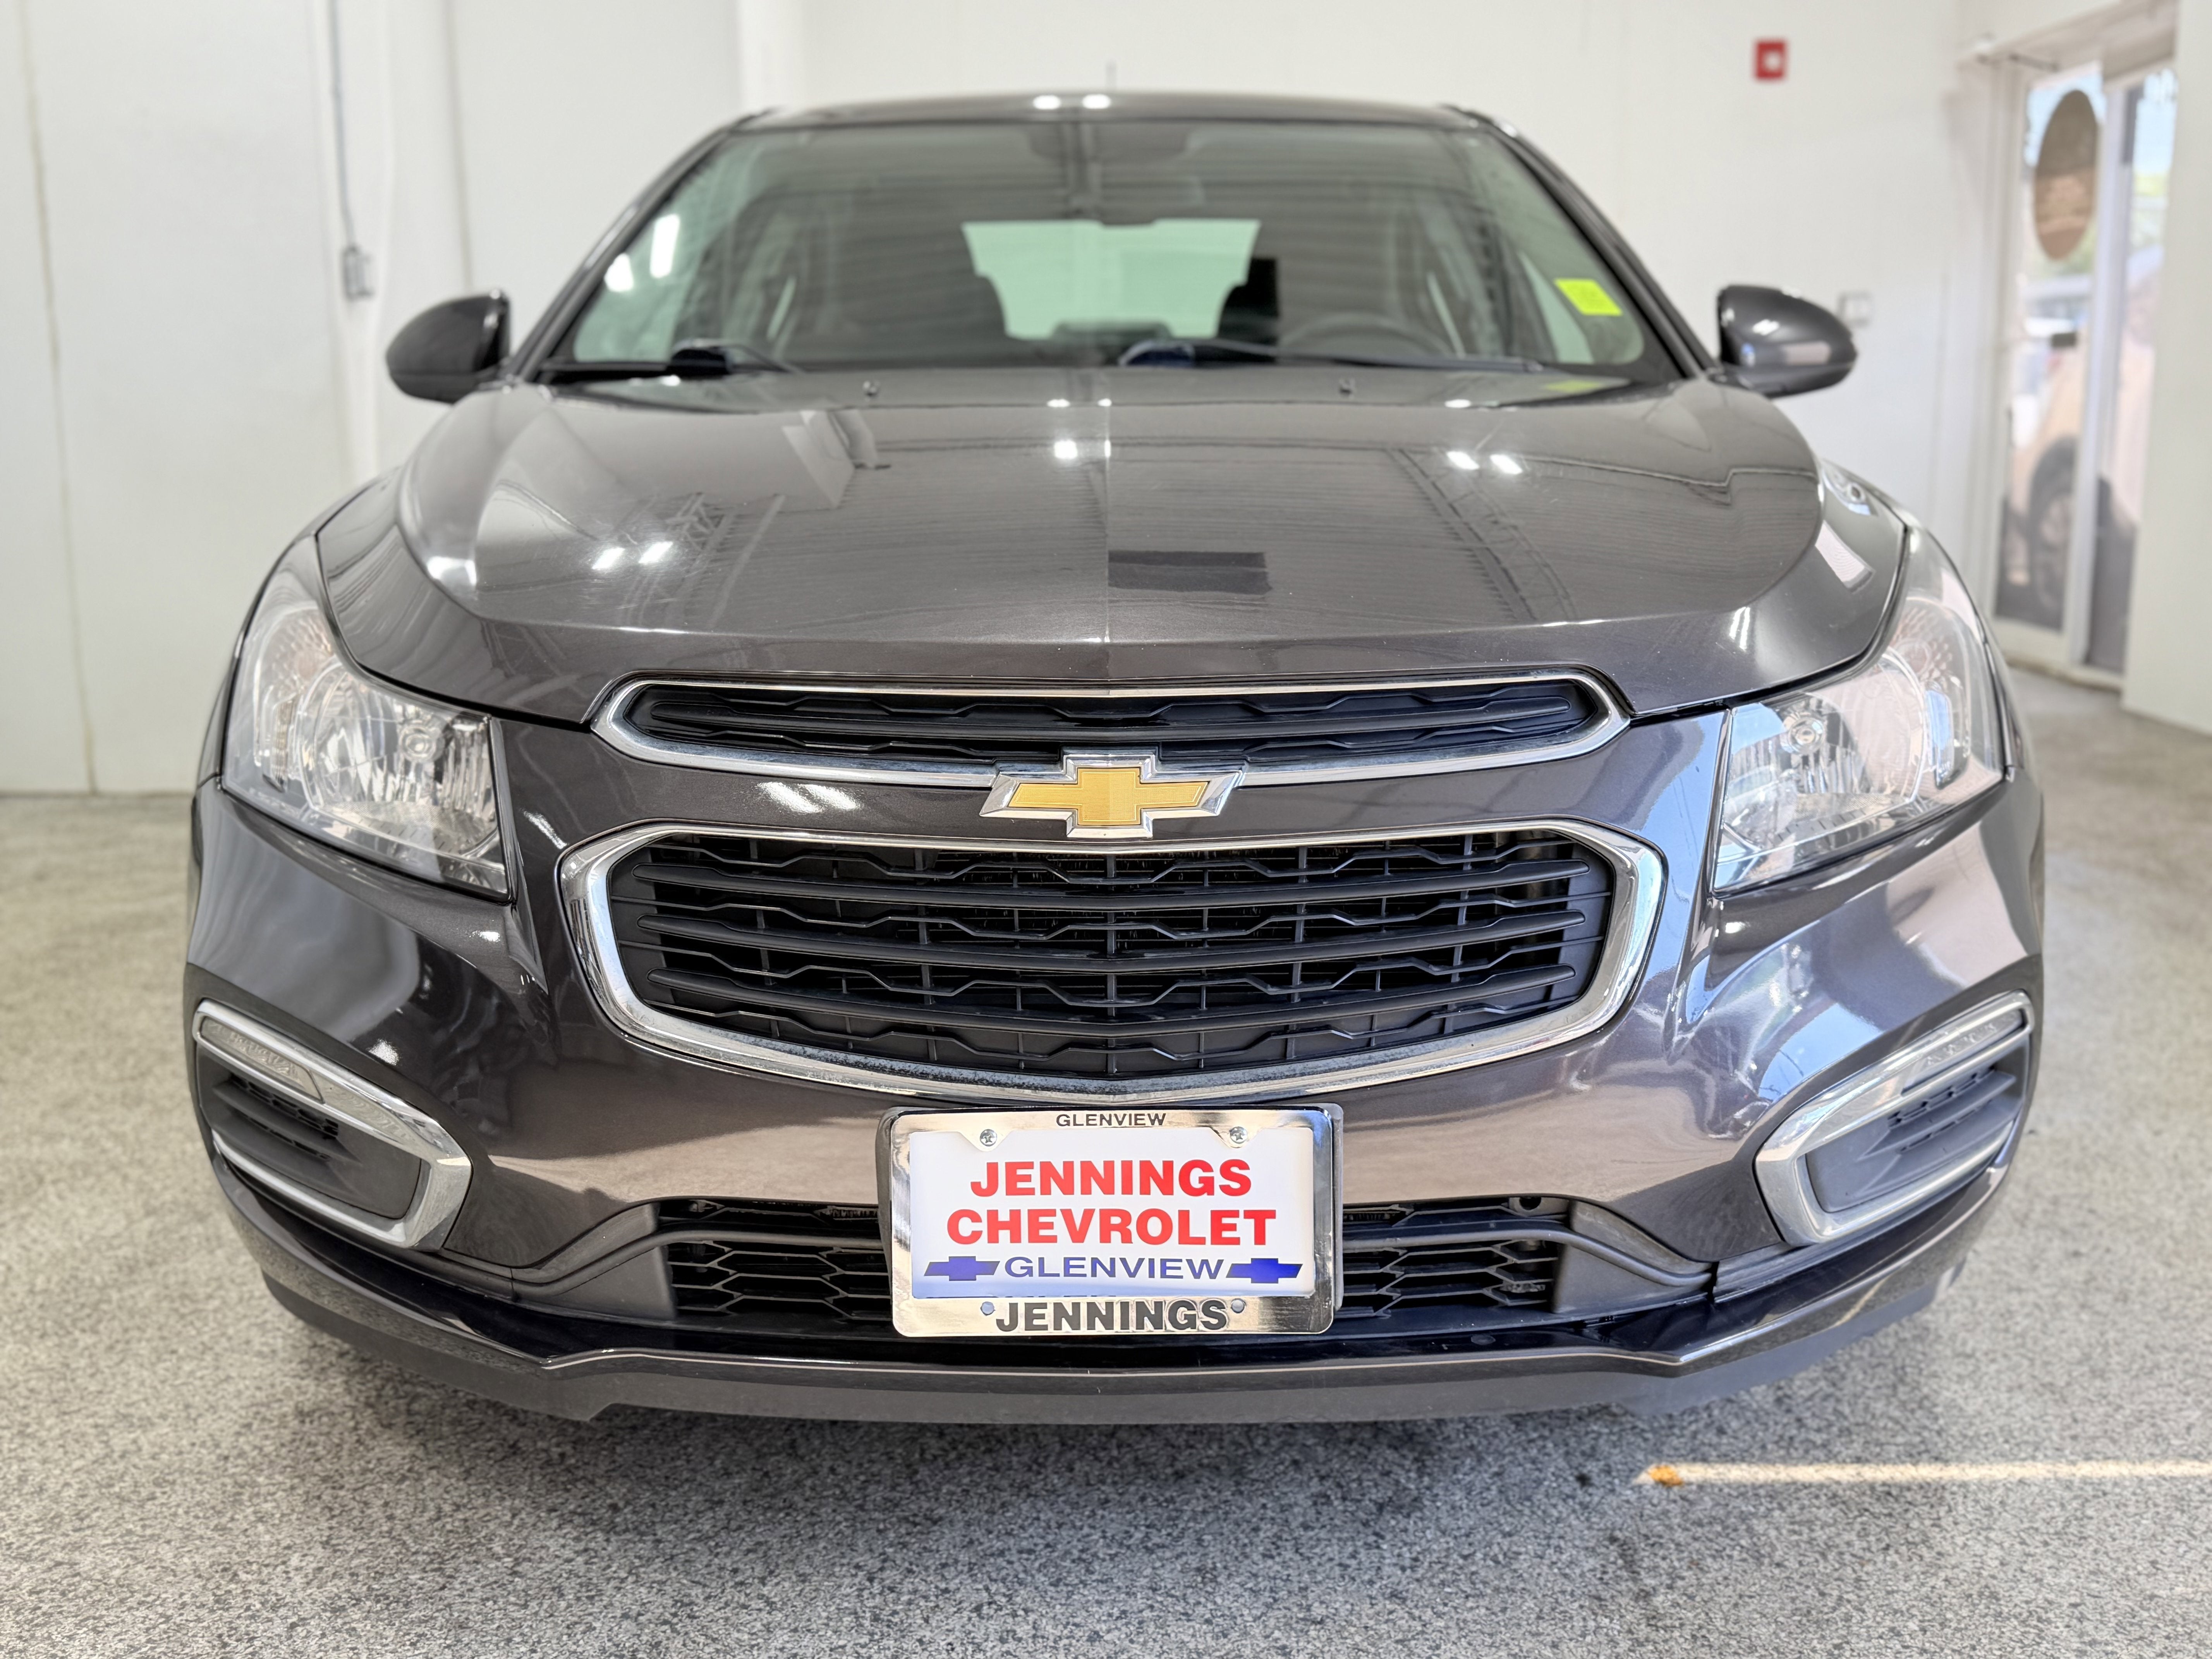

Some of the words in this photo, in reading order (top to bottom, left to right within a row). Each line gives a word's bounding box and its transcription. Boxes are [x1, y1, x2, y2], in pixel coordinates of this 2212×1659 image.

[1056, 1113, 1166, 1127] GLENVIEW
[970, 1159, 1252, 1197] JENNINGS
[947, 1208, 1276, 1245] CHEVROLET
[1005, 1256, 1225, 1279] GLENVIEW
[996, 1300, 1227, 1332] JENNINGS
